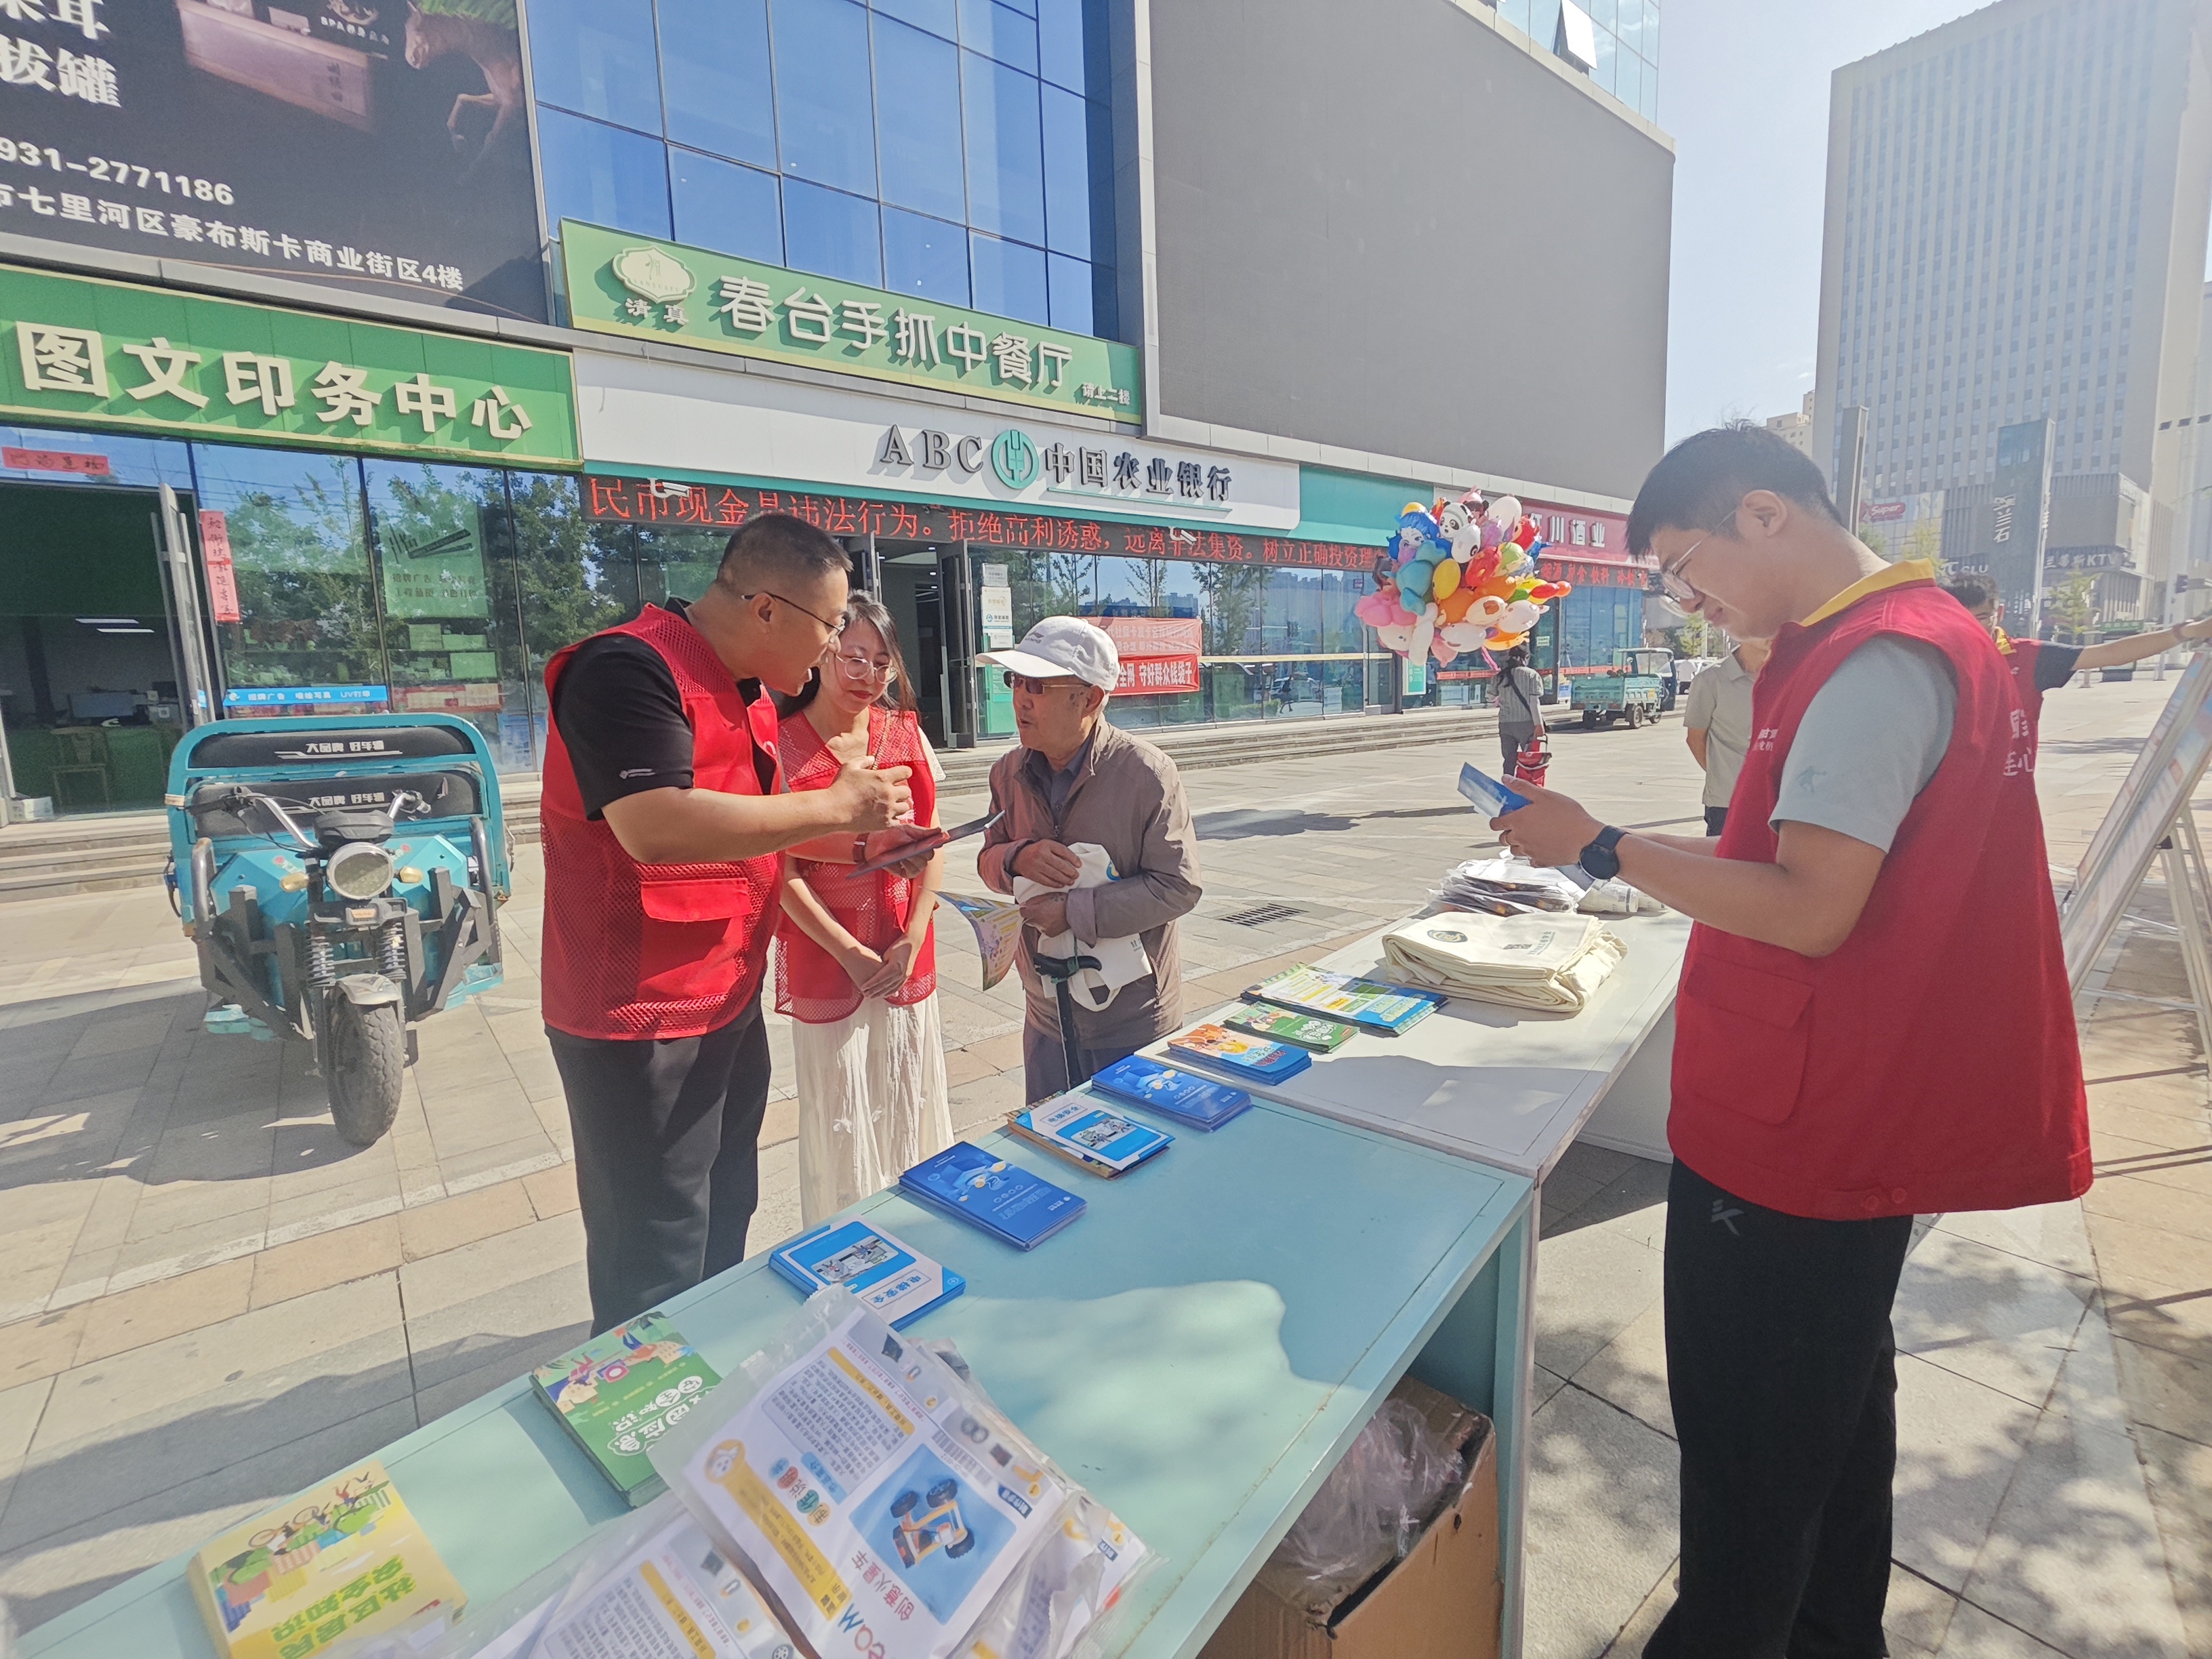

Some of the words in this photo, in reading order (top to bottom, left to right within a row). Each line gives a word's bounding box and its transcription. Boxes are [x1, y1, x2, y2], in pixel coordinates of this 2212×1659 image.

[0, 35, 122, 108] 拔罐
[0, 138, 234, 205] 931-2771186
[625, 298, 689, 325] 清真
[720, 276, 1072, 387] 春台手抓中餐厅
[16, 321, 532, 440] 图文印务中心
[1082, 382, 1130, 405] 请上二楼
[882, 424, 984, 474] ABC
[1045, 443, 1232, 501] 中国农业银行
[1871, 504, 1902, 516] Super
[1116, 662, 1135, 687] 全网
[1139, 661, 1192, 687] 守好群众钱袋子
[869, 1273, 922, 1305] 电梯安全
[611, 1375, 701, 1433] 安全知识
[269, 1557, 405, 1643] 安全知识
[278, 1574, 416, 1659] 社区居民
[848, 1549, 916, 1622] 创意火星车
